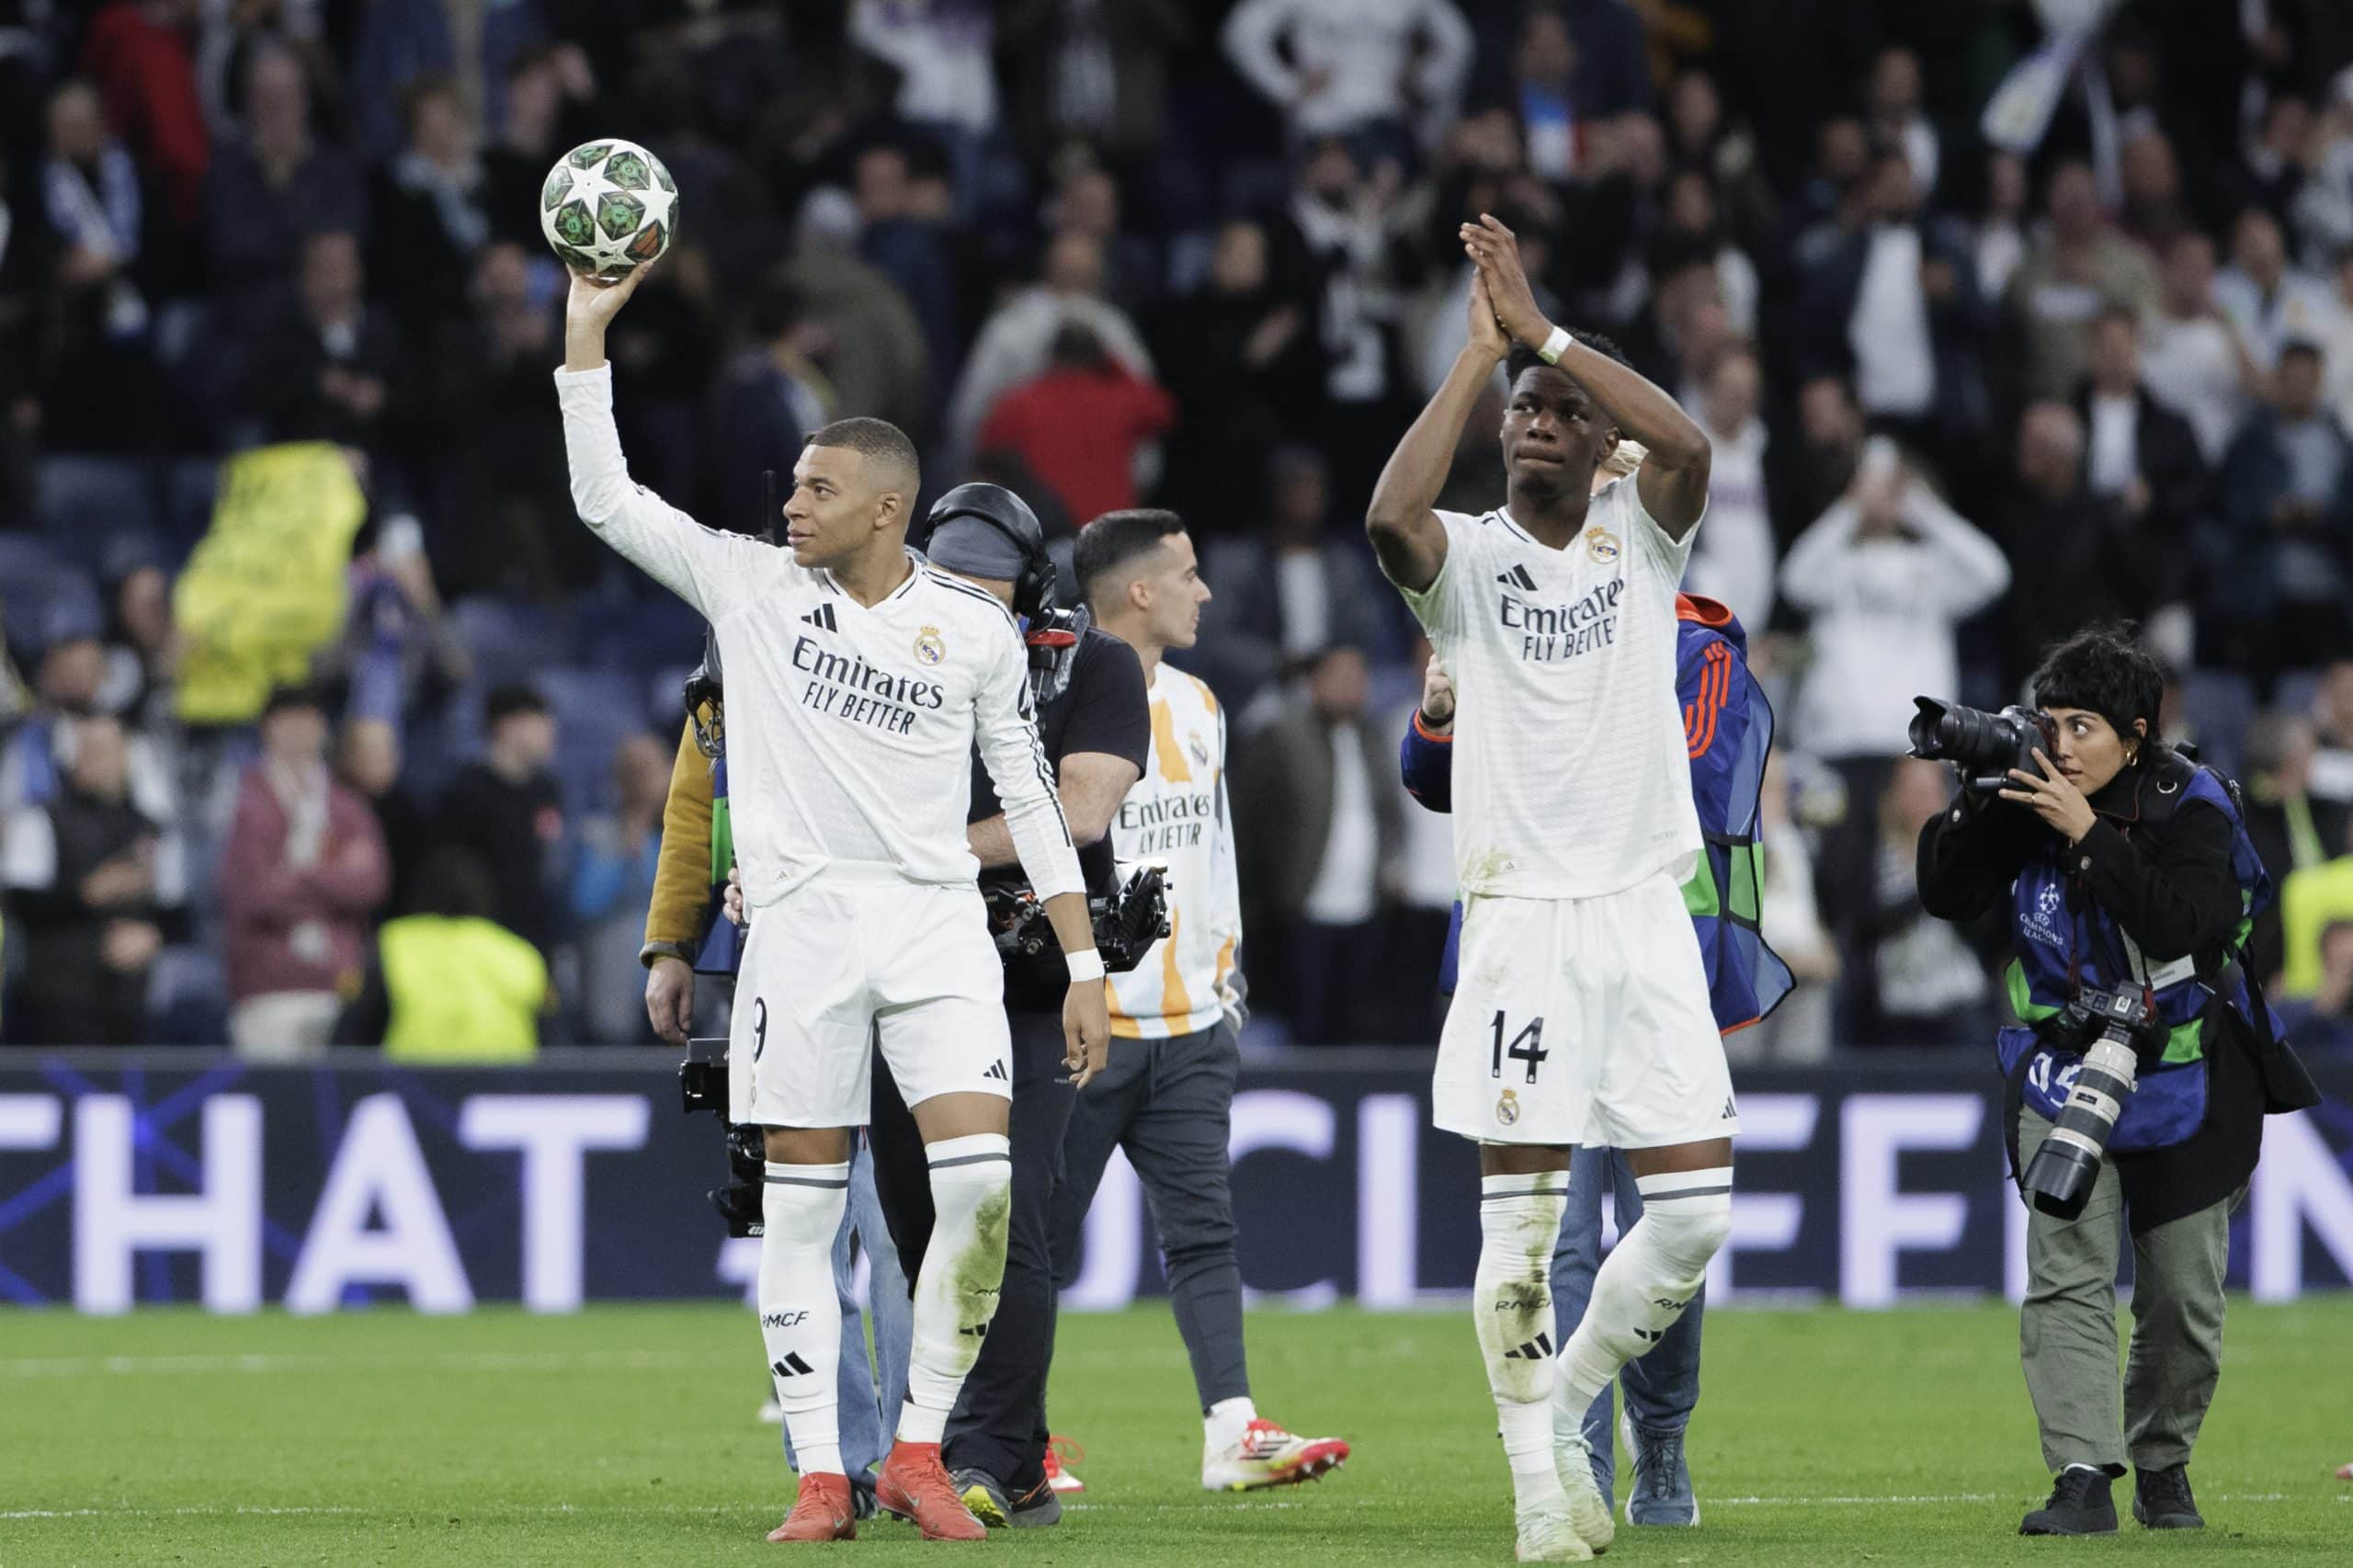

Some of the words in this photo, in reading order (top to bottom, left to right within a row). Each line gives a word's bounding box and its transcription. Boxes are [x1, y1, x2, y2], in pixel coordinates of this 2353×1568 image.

[1522, 636, 1556, 661] FLY
[1563, 615, 1618, 659] BETTE
[791, 635, 945, 710] Emirates
[801, 680, 839, 713] FLY
[839, 693, 916, 735] BETTER
[1489, 1009, 1551, 1085] 14
